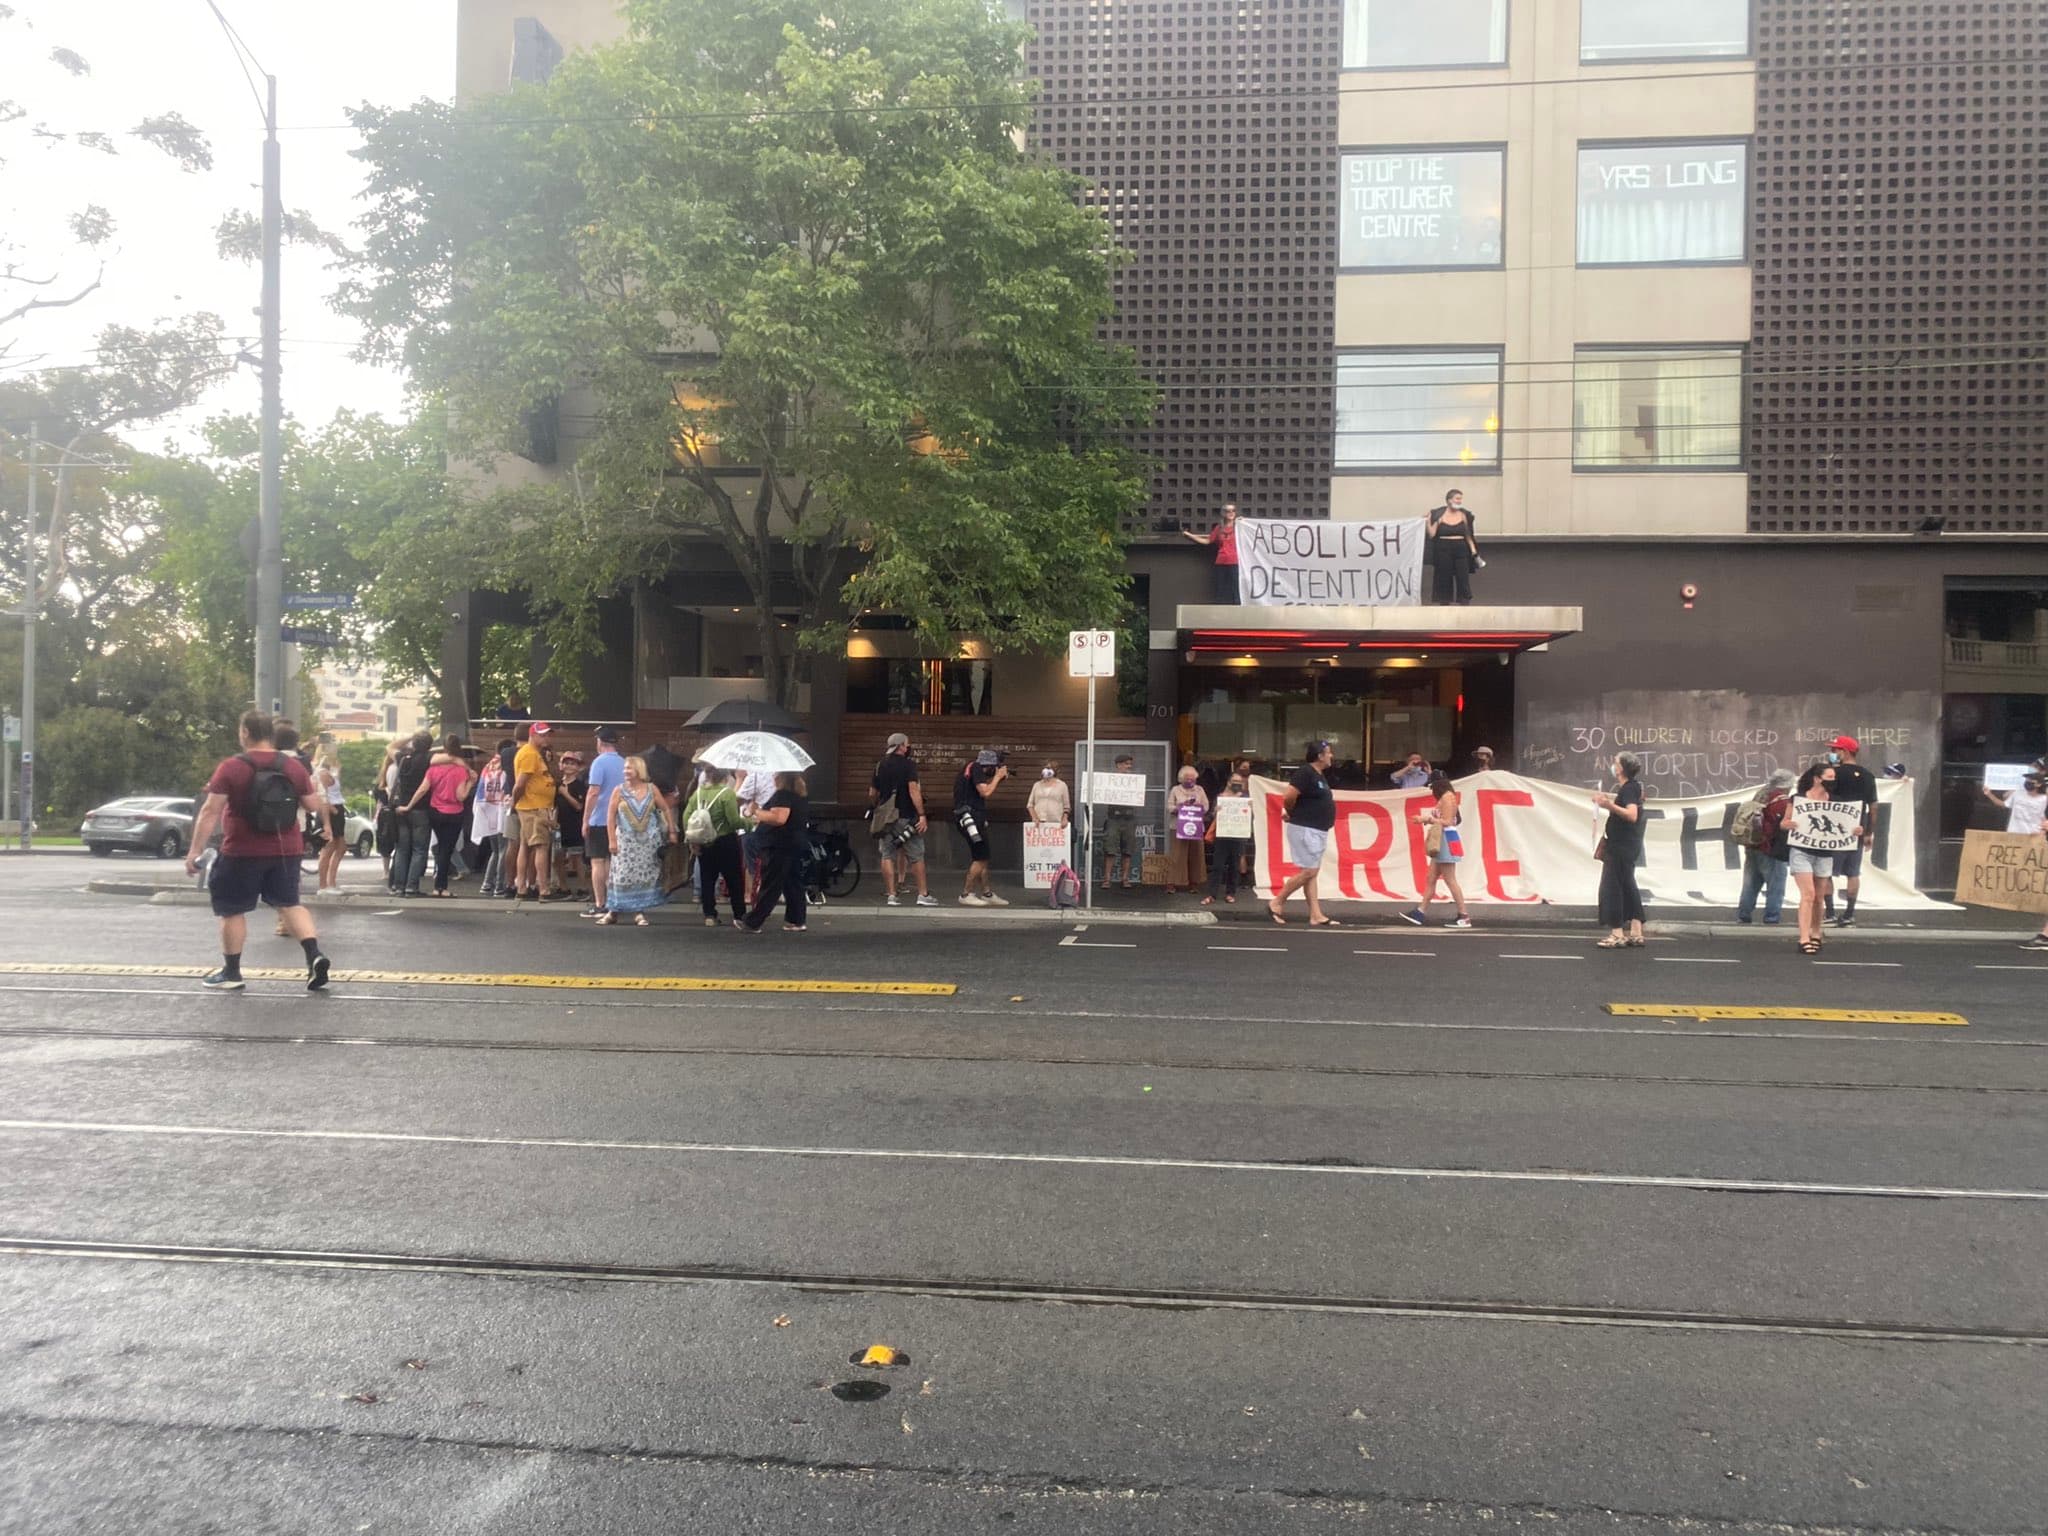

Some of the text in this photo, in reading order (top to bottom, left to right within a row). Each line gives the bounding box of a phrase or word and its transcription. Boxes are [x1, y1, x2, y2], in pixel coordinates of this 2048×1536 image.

[1351, 157, 1443, 183] STOP THE
[1600, 159, 1736, 189] YRS LONG
[1351, 185, 1453, 211] TORTURER
[1360, 214, 1440, 238] CENTRE
[1253, 523, 1401, 558] ABOLISH
[1250, 565, 1412, 599] DETENTION
[1151, 704, 1174, 718] 701
[1570, 727, 1606, 752] 30
[1615, 726, 1693, 746] CHILDREN
[1711, 729, 1778, 745] LOCKED
[1858, 728, 1911, 745] HERE
[1595, 757, 1611, 770] AN
[1795, 802, 1861, 819] REFUGEES
[1025, 826, 1065, 838] WELCOME
[1026, 837, 1066, 847] REFUGEES
[1790, 829, 1857, 849] WELCOME
[1029, 863, 1042, 871] SET
[1986, 845, 2048, 870] FREE AL
